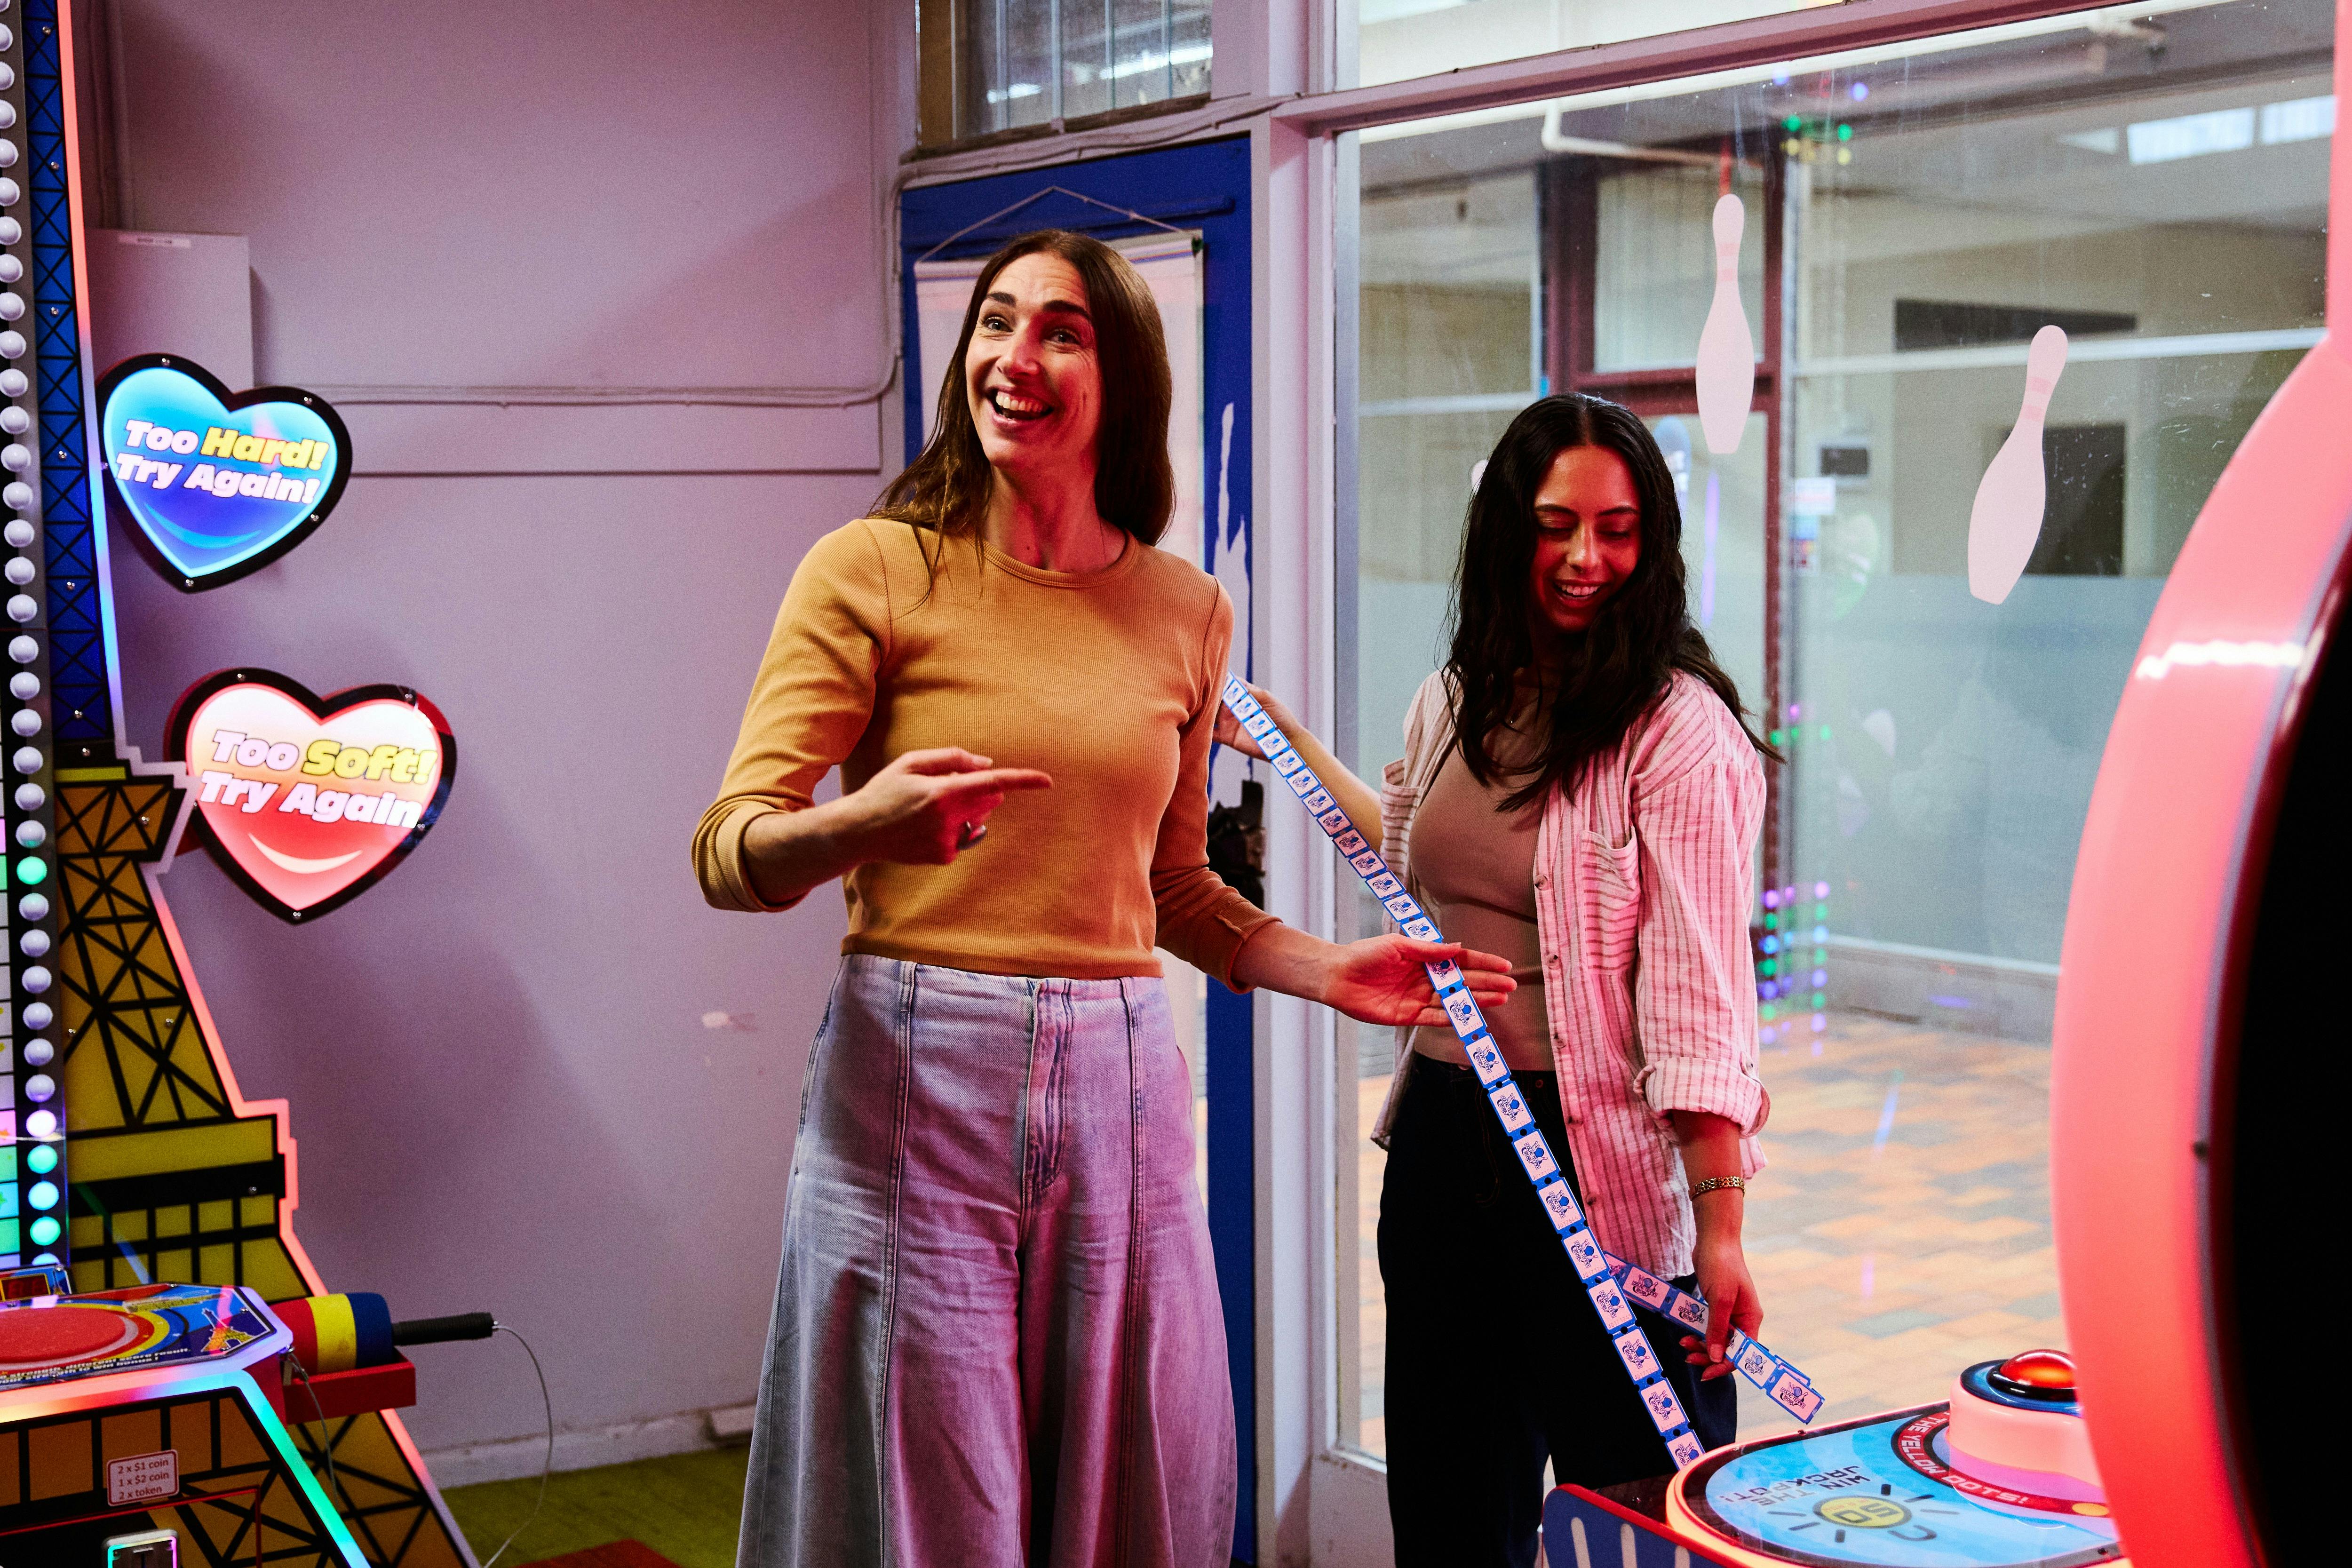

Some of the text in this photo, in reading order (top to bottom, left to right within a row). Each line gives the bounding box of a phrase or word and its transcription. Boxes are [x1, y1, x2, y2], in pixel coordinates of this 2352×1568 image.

[126, 419, 330, 470] Too Hard!
[115, 453, 321, 504] Try Again!
[212, 729, 438, 784] Too Soft!
[199, 770, 423, 829] Try Again
[118, 1465, 124, 1474] 2
[135, 1462, 146, 1472] $1
[149, 1459, 169, 1468] coin
[1900, 1416, 2029, 1504] THE YELLOW DOTS!
[135, 1474, 147, 1484] $2
[149, 1472, 169, 1481] coin
[135, 1487, 162, 1496] token
[1720, 1466, 1861, 1503] JACKPOT!
[1820, 1475, 1871, 1490] WIN
[1750, 1488, 1817, 1505] THE
[1832, 1503, 1900, 1523] 50
